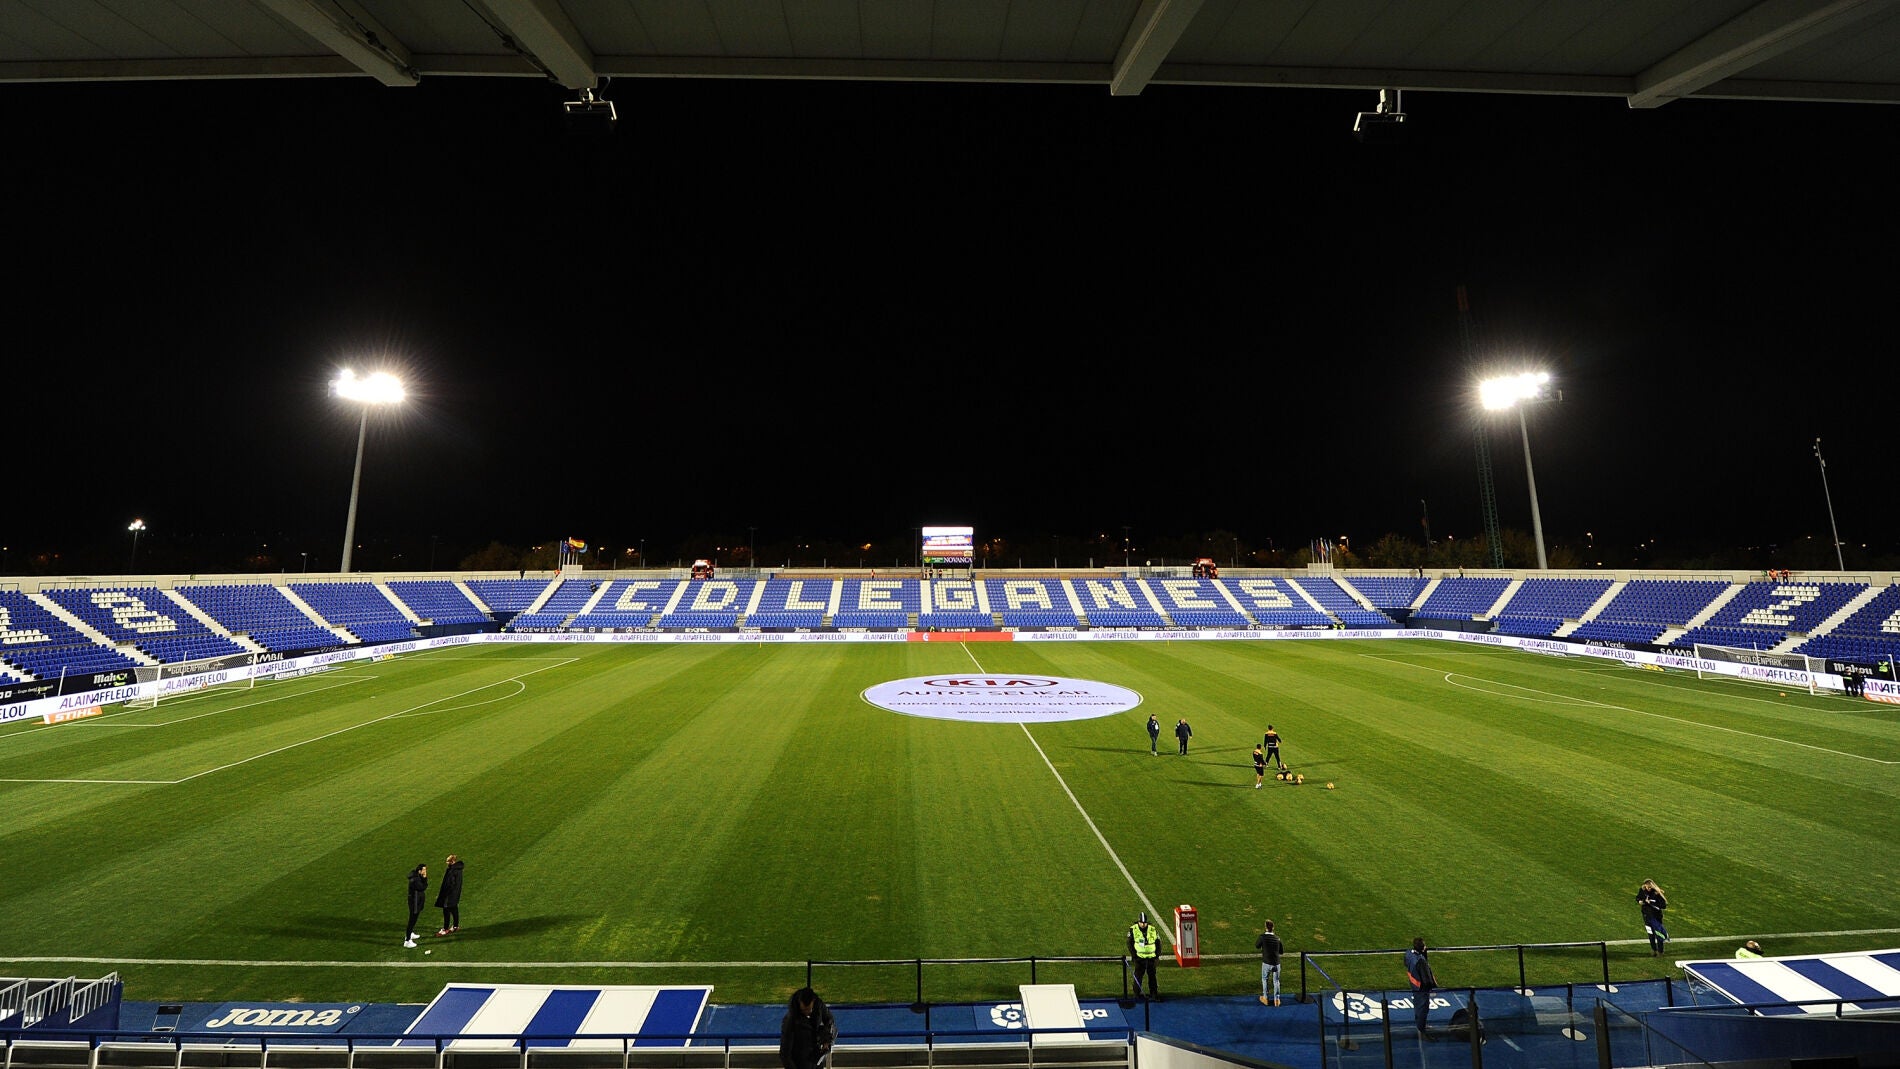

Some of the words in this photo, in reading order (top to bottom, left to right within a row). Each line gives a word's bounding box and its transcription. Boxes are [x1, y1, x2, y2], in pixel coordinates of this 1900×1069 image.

[1585, 639, 1603, 647] Zona
[1605, 640, 1626, 649] Verde
[54, 706, 97, 721] STIHL
